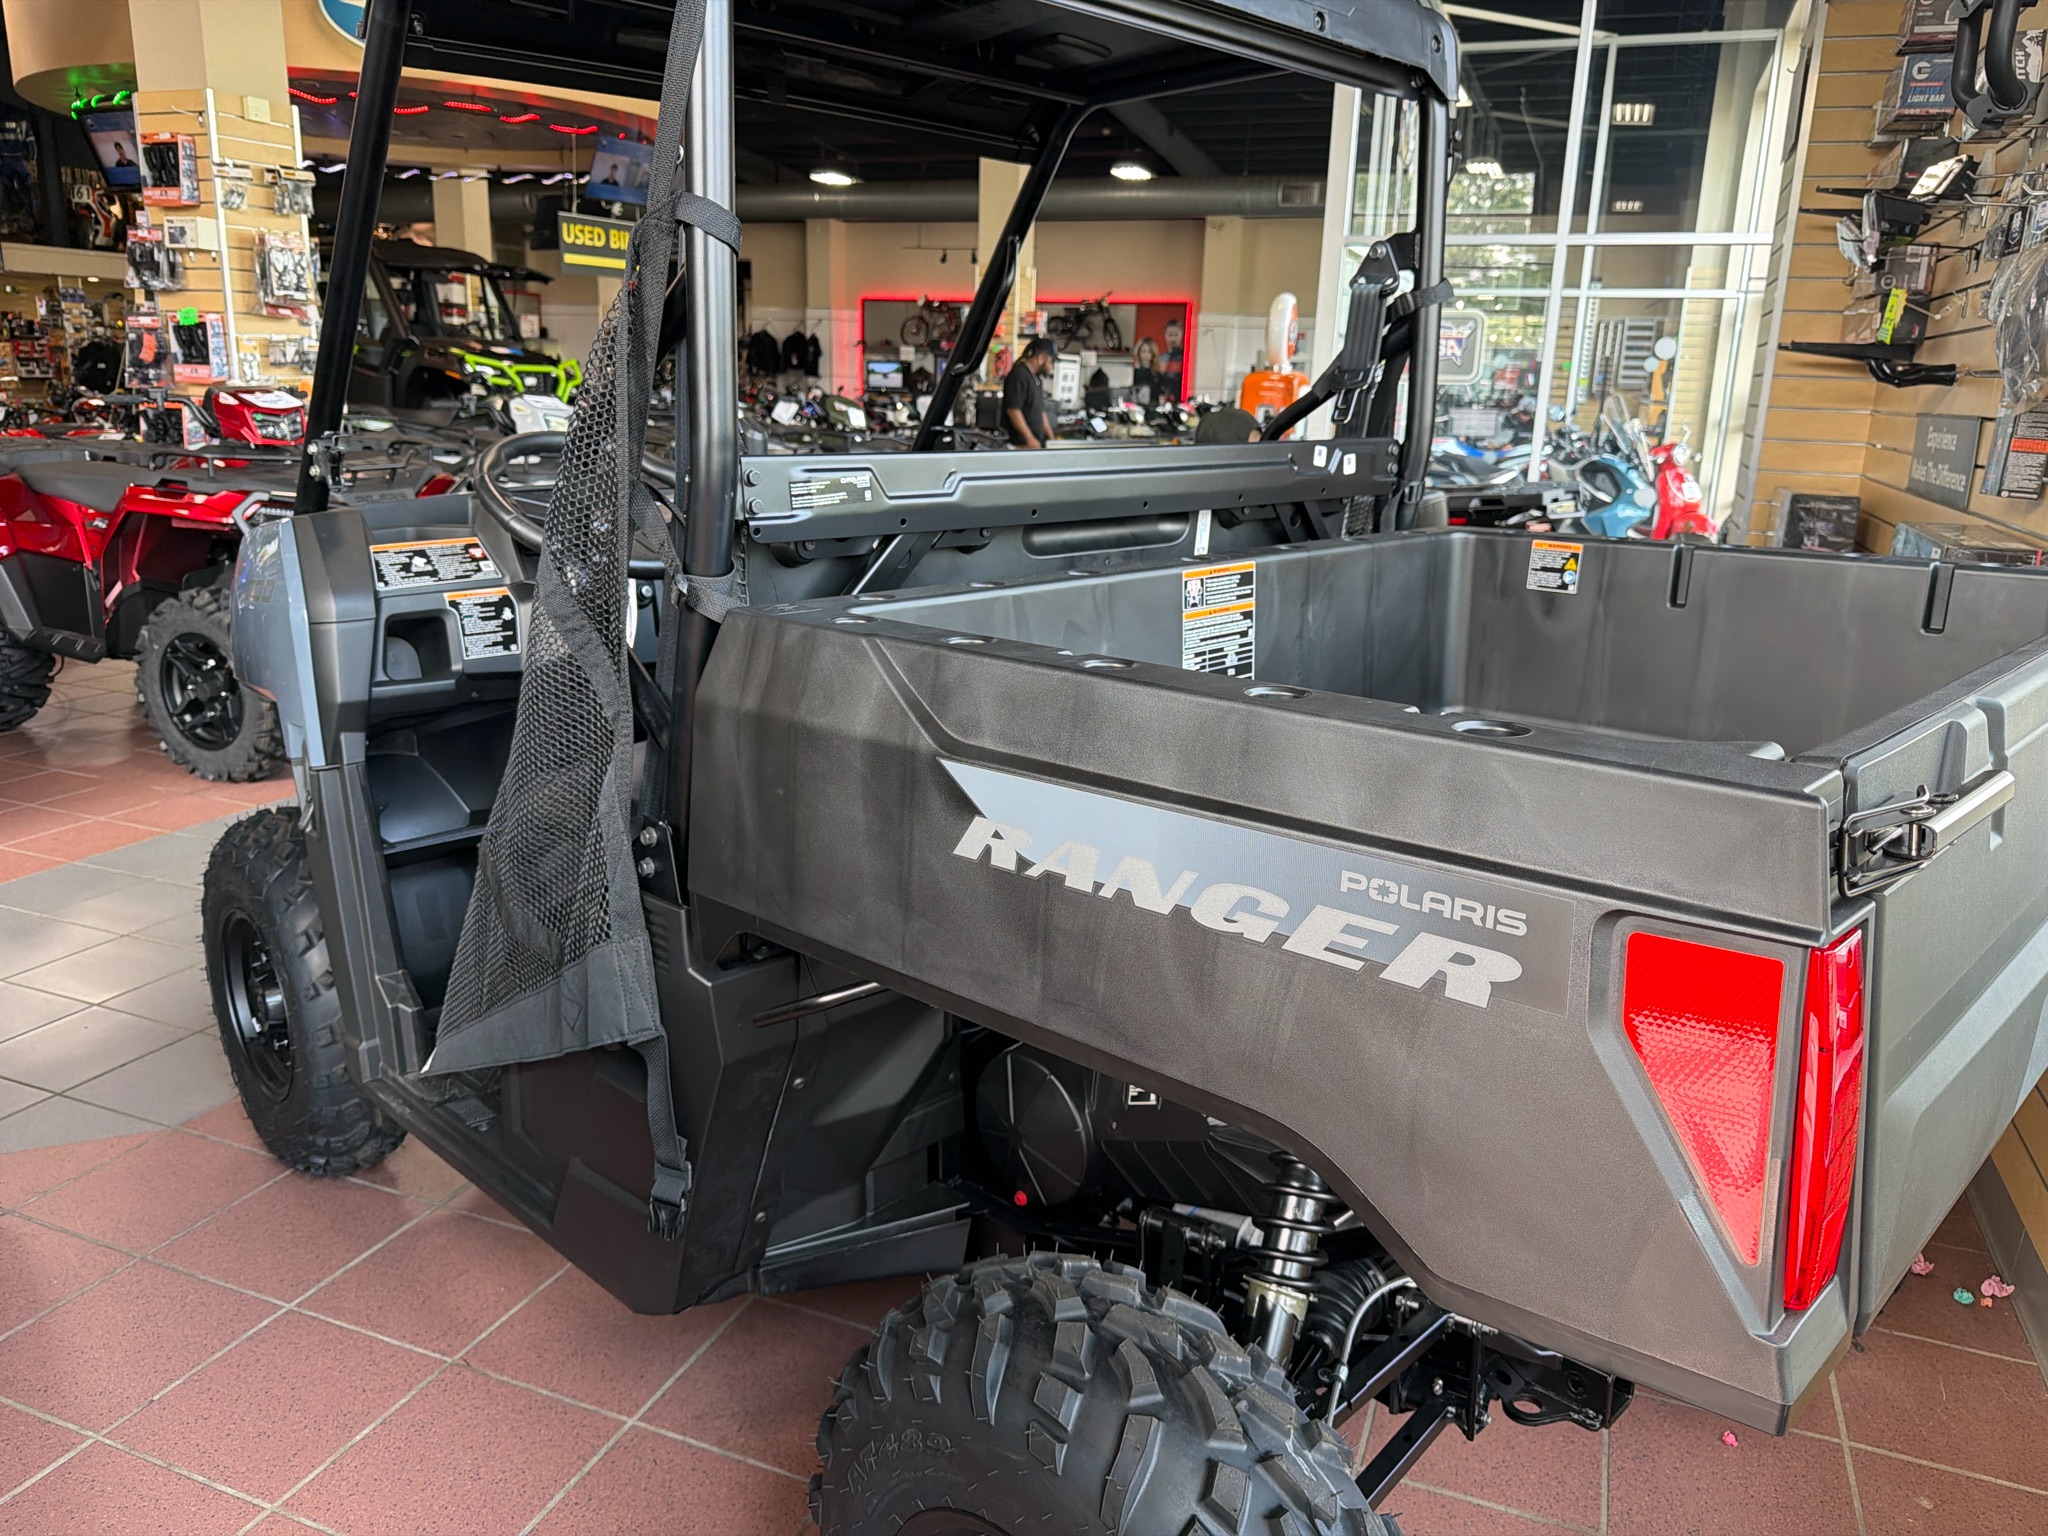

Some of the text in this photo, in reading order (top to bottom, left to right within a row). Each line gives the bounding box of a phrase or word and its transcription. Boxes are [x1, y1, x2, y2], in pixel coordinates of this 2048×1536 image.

[2014, 51, 2026, 80] ITCH
[1907, 94, 1946, 103] LIGHT BAR
[562, 222, 606, 248] USED
[1926, 425, 1959, 454] Experience
[1910, 457, 1967, 493] Makes The Difference
[952, 816, 1523, 1008] RANGER
[1341, 870, 1528, 936] POLARIS
